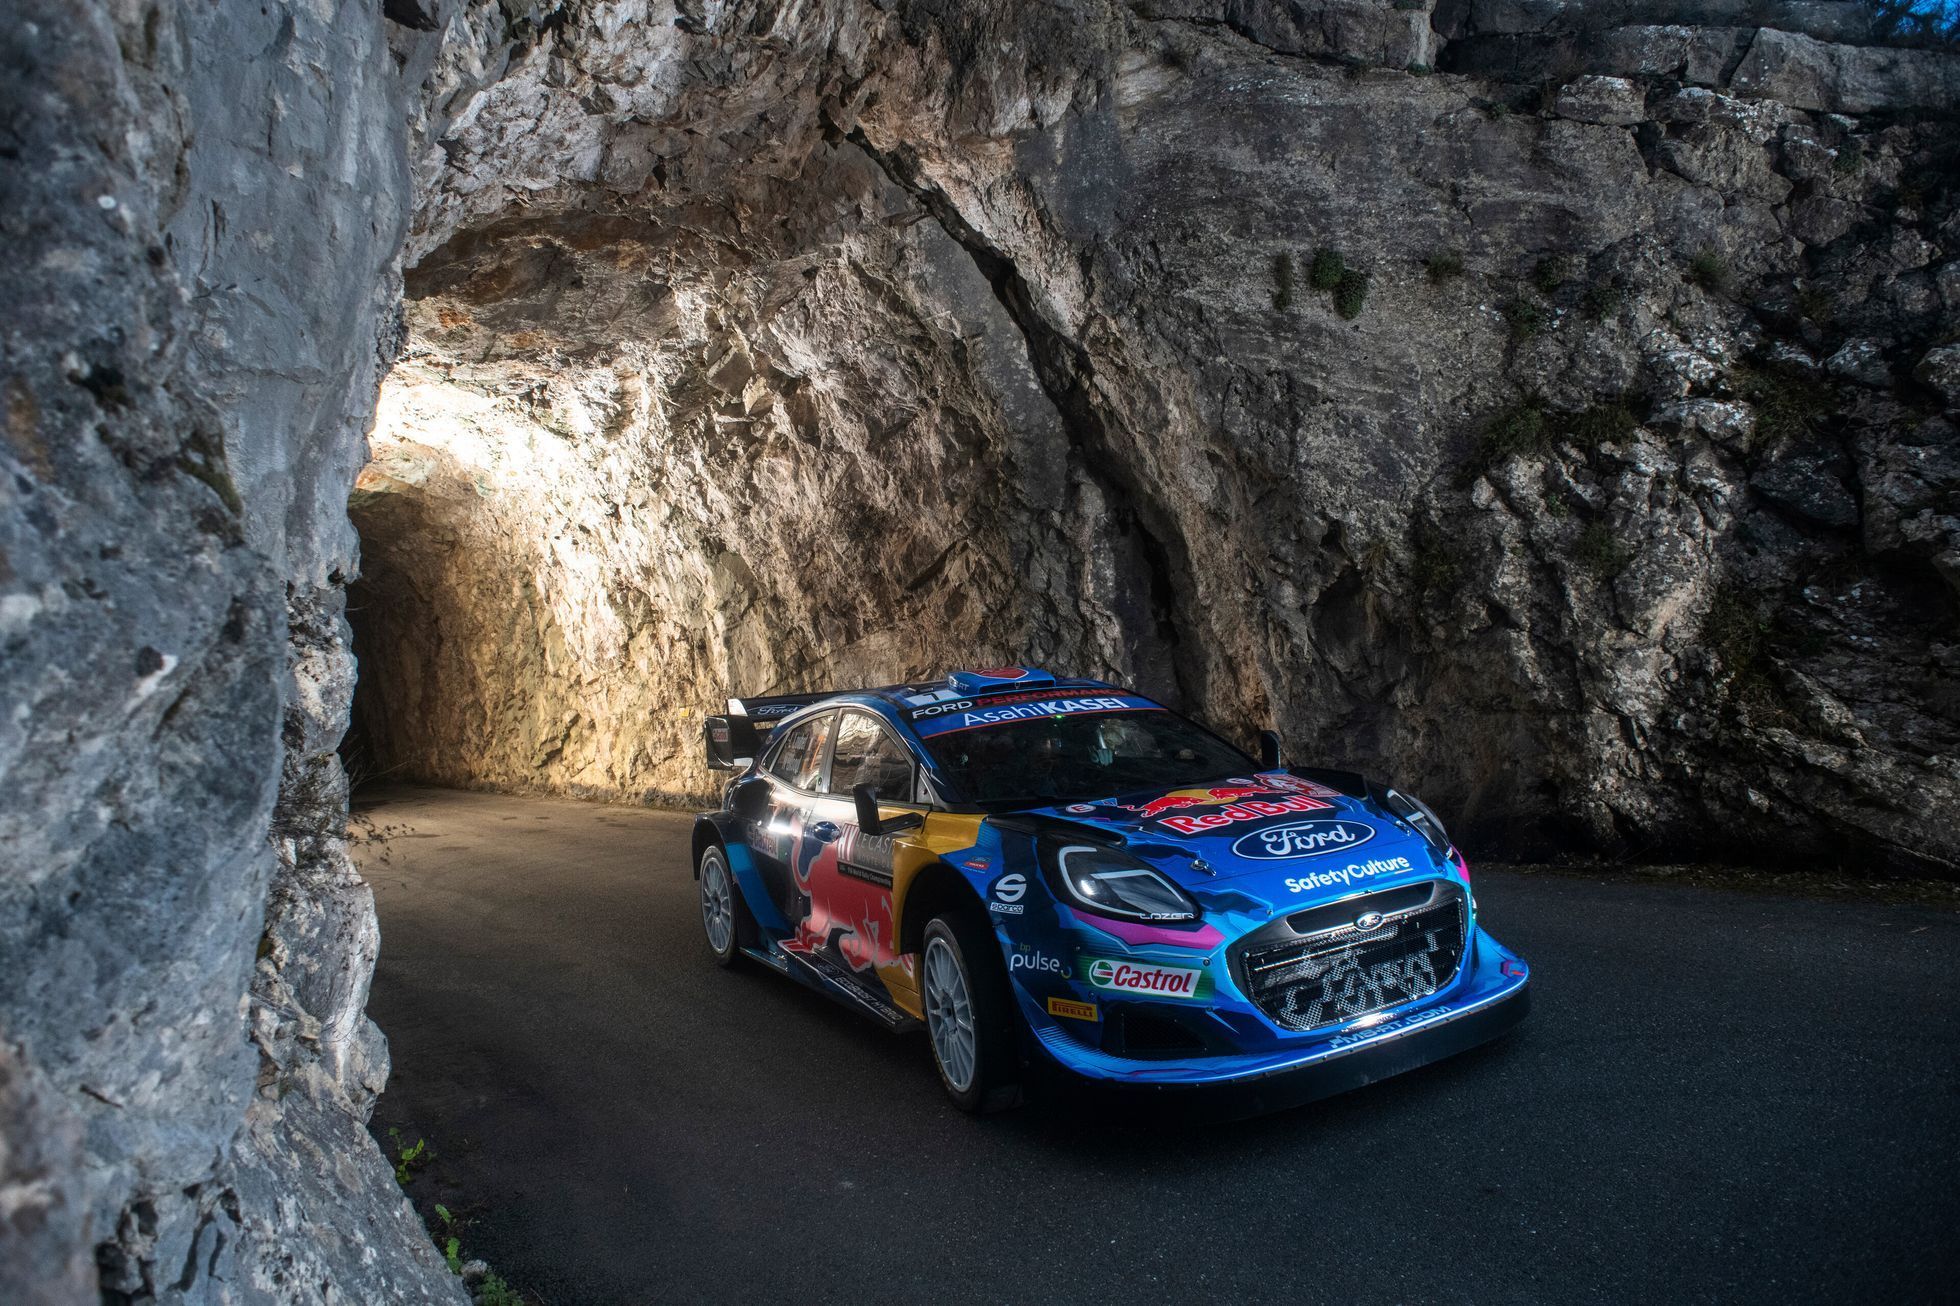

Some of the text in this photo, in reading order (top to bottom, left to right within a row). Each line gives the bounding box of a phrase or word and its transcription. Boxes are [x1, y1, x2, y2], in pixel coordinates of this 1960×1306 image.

[912, 688, 1129, 719] FORD PERFORMANCE
[1260, 824, 1356, 855] Ford
[1285, 856, 1410, 893] SafetyCulture
[992, 904, 1022, 913] sparco
[1020, 943, 1031, 952] bp
[1010, 950, 1060, 972] pulse
[1114, 964, 1193, 992] Castrol
[1052, 1001, 1094, 1018] PIRELLI
